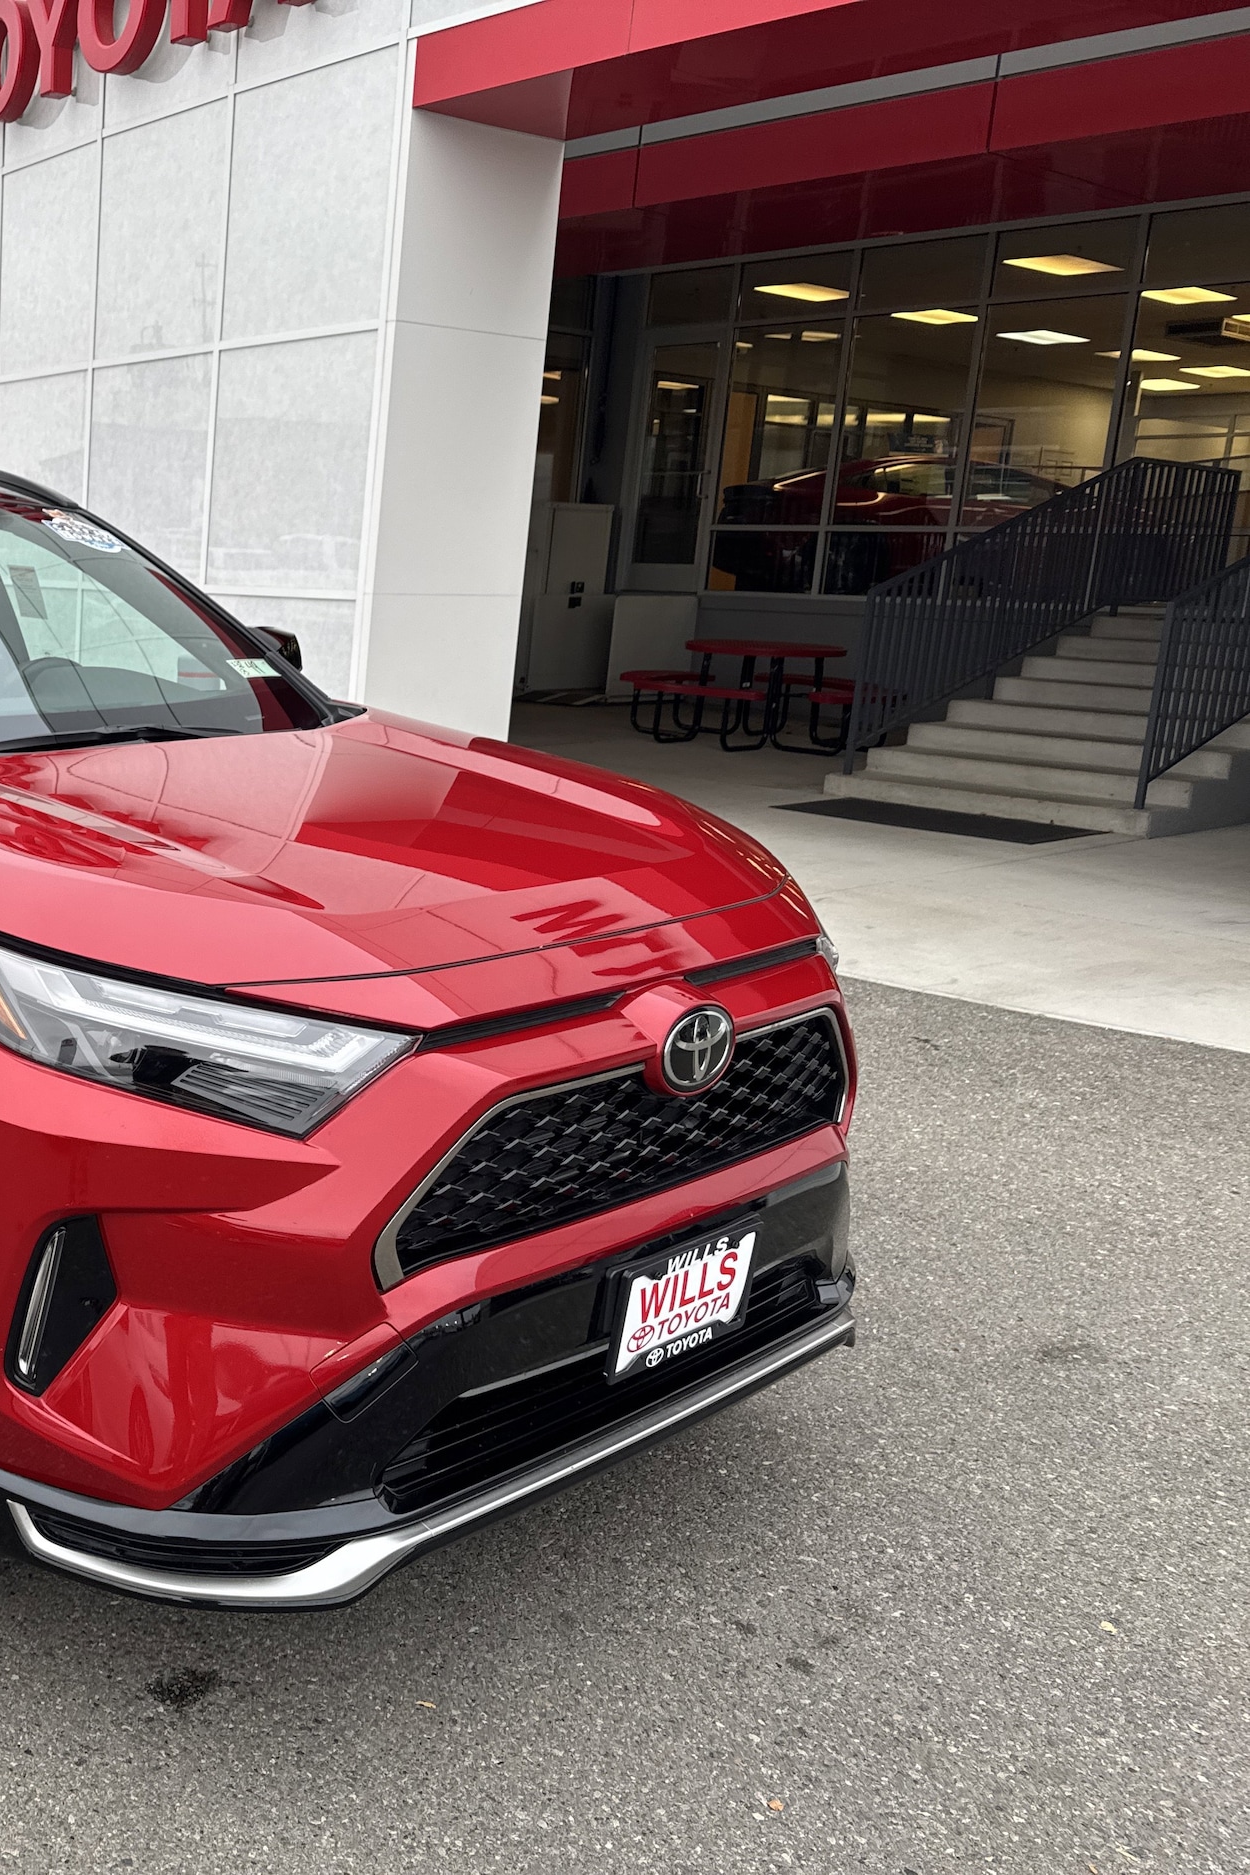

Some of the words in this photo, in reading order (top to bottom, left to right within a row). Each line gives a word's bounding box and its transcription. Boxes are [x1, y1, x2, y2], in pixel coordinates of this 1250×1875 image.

[667, 1236, 729, 1275] WILLS
[640, 1251, 738, 1324] WILLS
[657, 1291, 730, 1340] TOYOTA
[666, 1326, 713, 1358] TOYOTA
